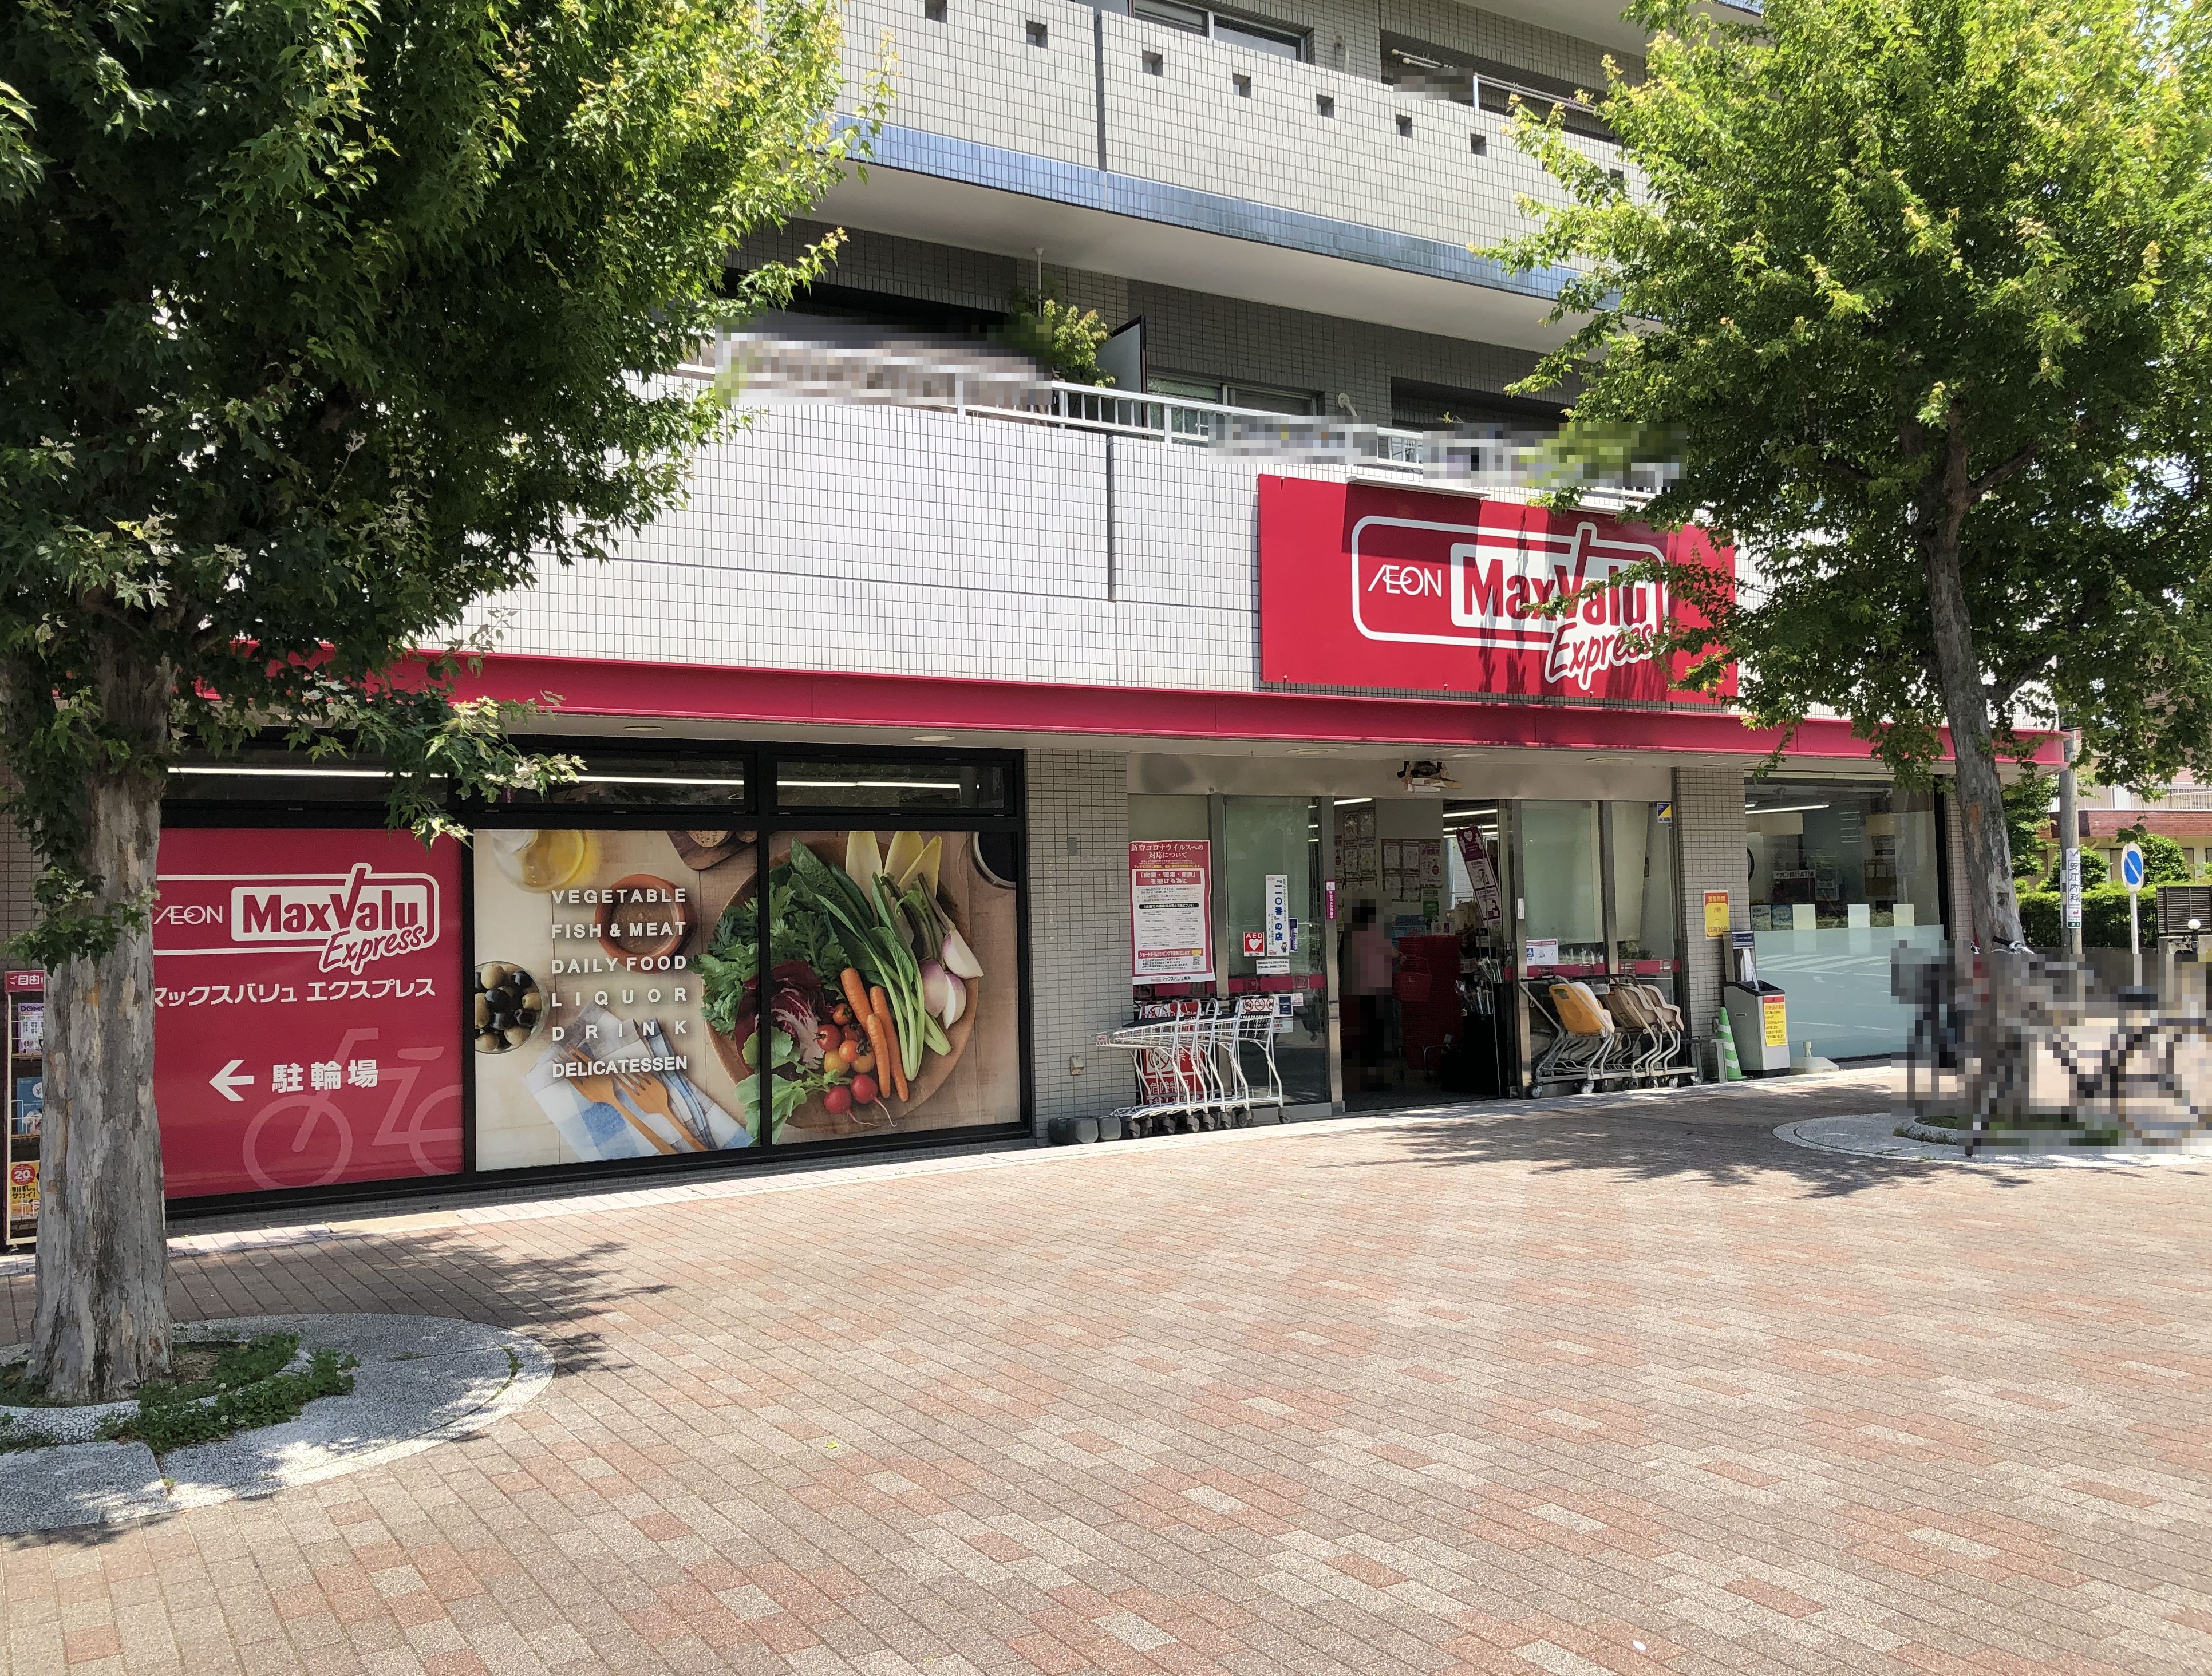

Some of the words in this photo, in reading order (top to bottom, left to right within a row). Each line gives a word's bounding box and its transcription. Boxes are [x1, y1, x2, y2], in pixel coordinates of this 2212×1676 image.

[1463, 528, 1647, 626] MaxValu
[243, 868, 418, 934] MaxValu
[551, 888, 686, 904] VEGETABLE
[551, 923, 601, 939] FISH
[609, 923, 621, 938] &
[629, 922, 686, 937] MEAT
[323, 925, 425, 971] Express
[551, 958, 619, 974] DAILY
[626, 955, 686, 971] FOOD
[9, 974, 44, 985] ご自由
[154, 983, 297, 1007] マックスバリュ
[306, 978, 436, 1001] エクスプレス
[552, 987, 687, 1007] LIQUOR
[552, 1020, 687, 1041] DRINK
[272, 1059, 378, 1094] 駐輪場
[552, 1056, 688, 1078] DELICATESSEN
